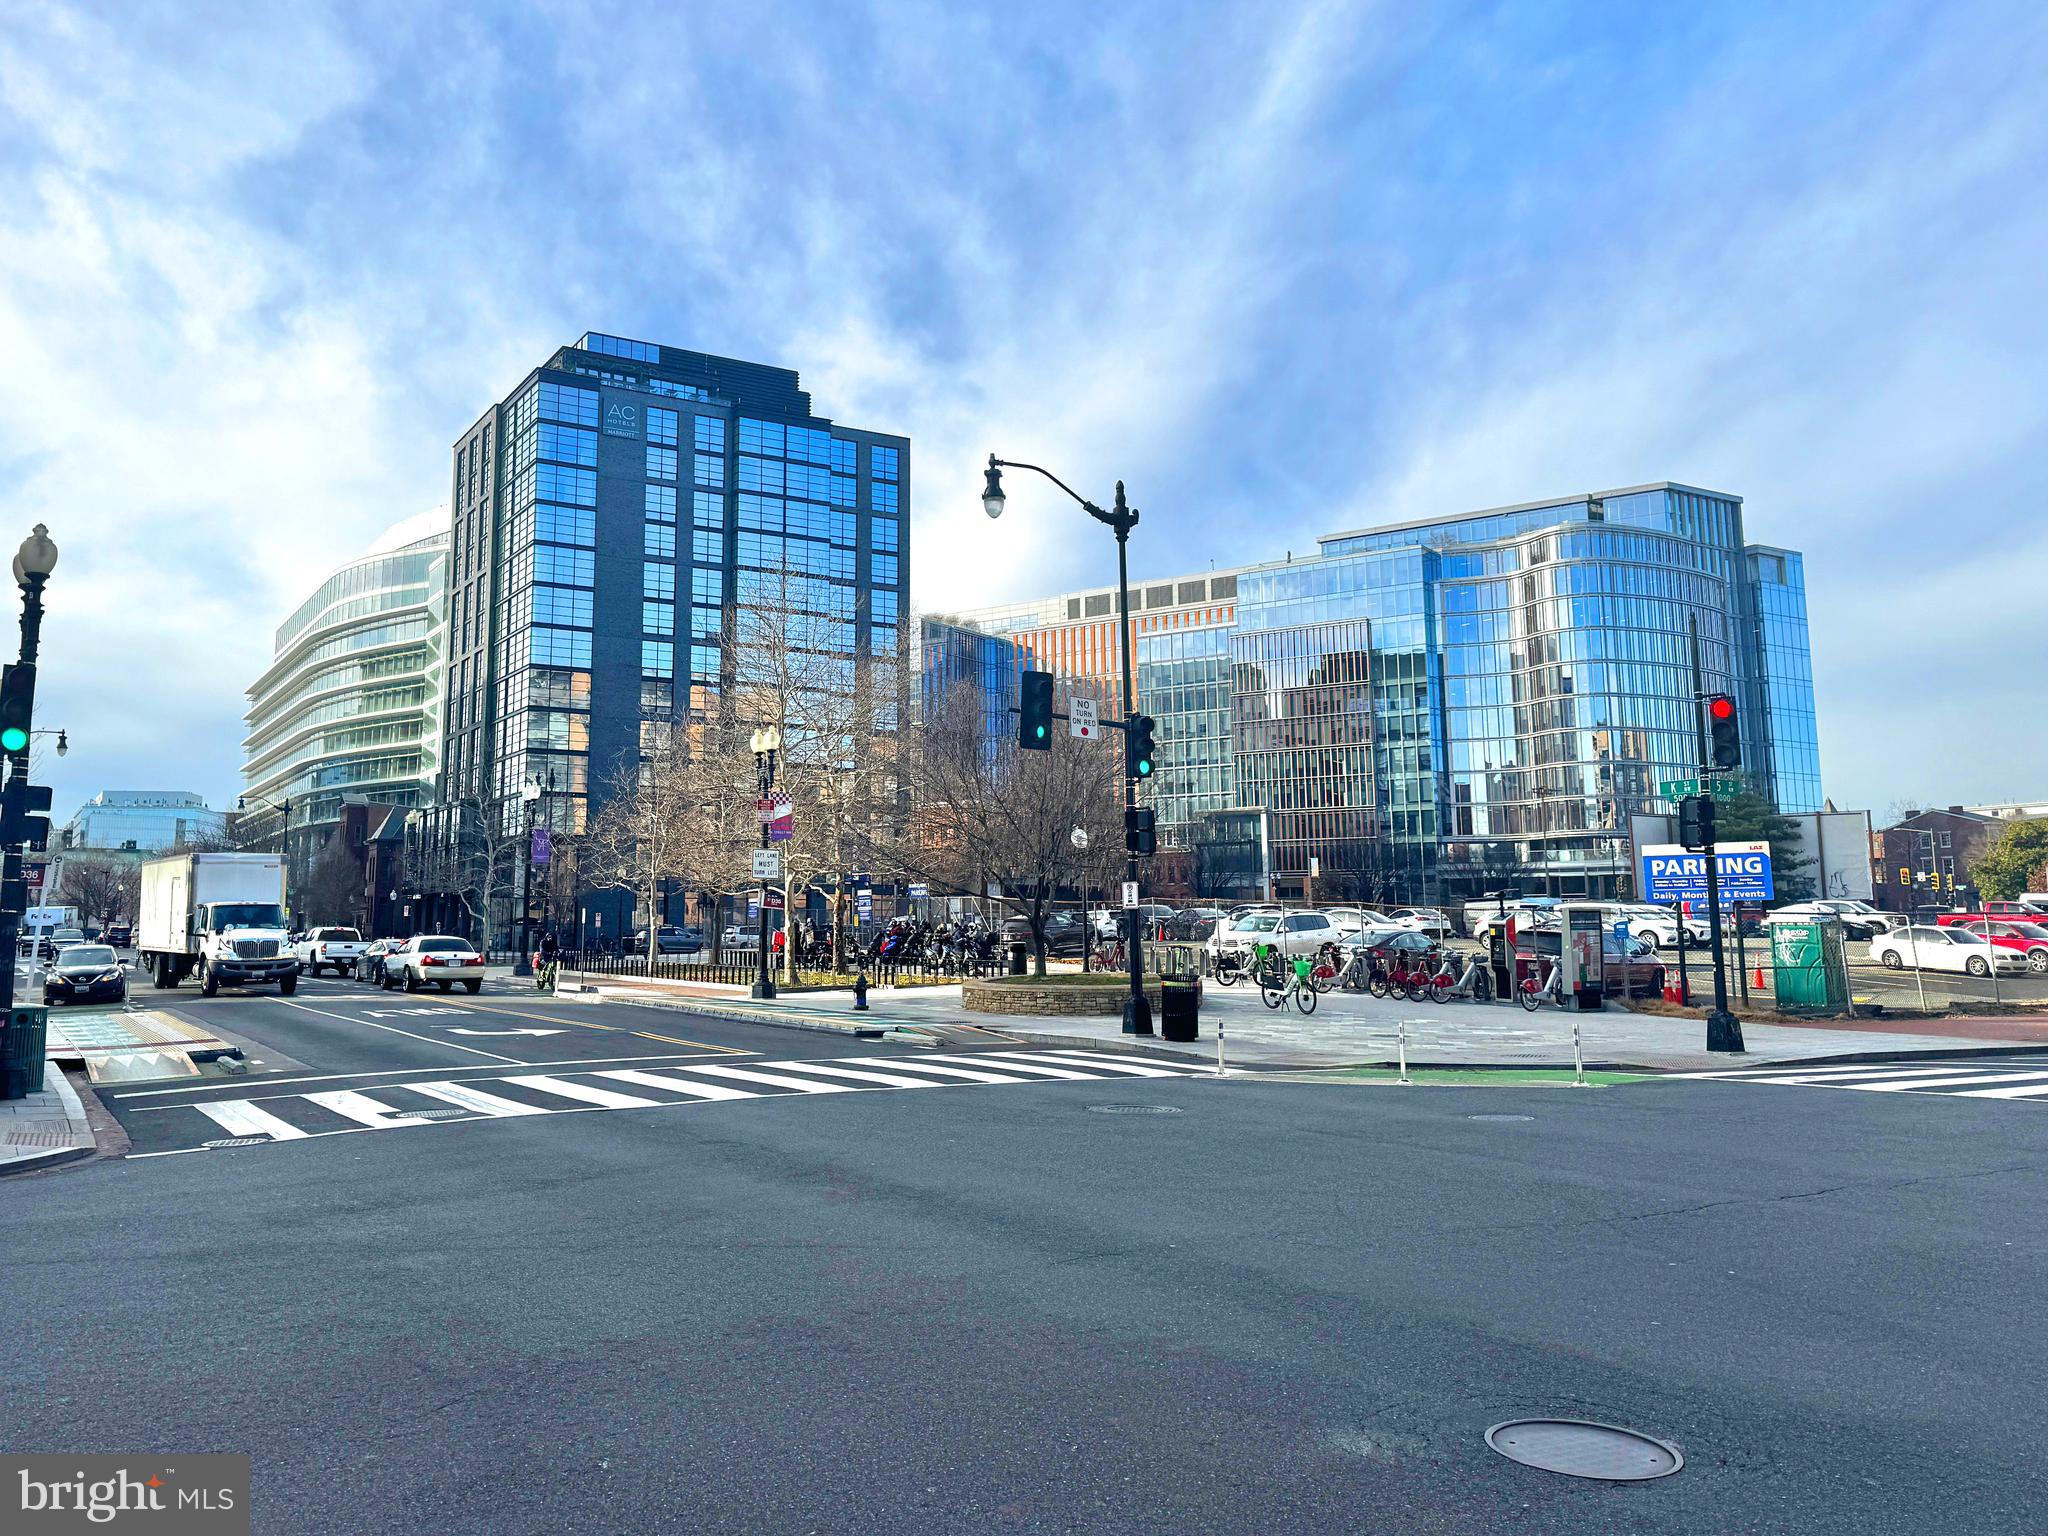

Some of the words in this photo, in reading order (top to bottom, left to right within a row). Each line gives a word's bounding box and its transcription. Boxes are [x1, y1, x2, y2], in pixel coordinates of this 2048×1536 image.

[608, 403, 636, 420] AC
[1077, 700, 1090, 709] NO
[1076, 709, 1093, 718] TURN
[1072, 717, 1082, 725] ON
[1083, 718, 1097, 727] RED
[1670, 783, 1677, 794] K
[1716, 781, 1721, 792] 5
[1653, 892, 1679, 901] Daily,
[1724, 890, 1731, 898] &
[1733, 890, 1766, 898] Events
